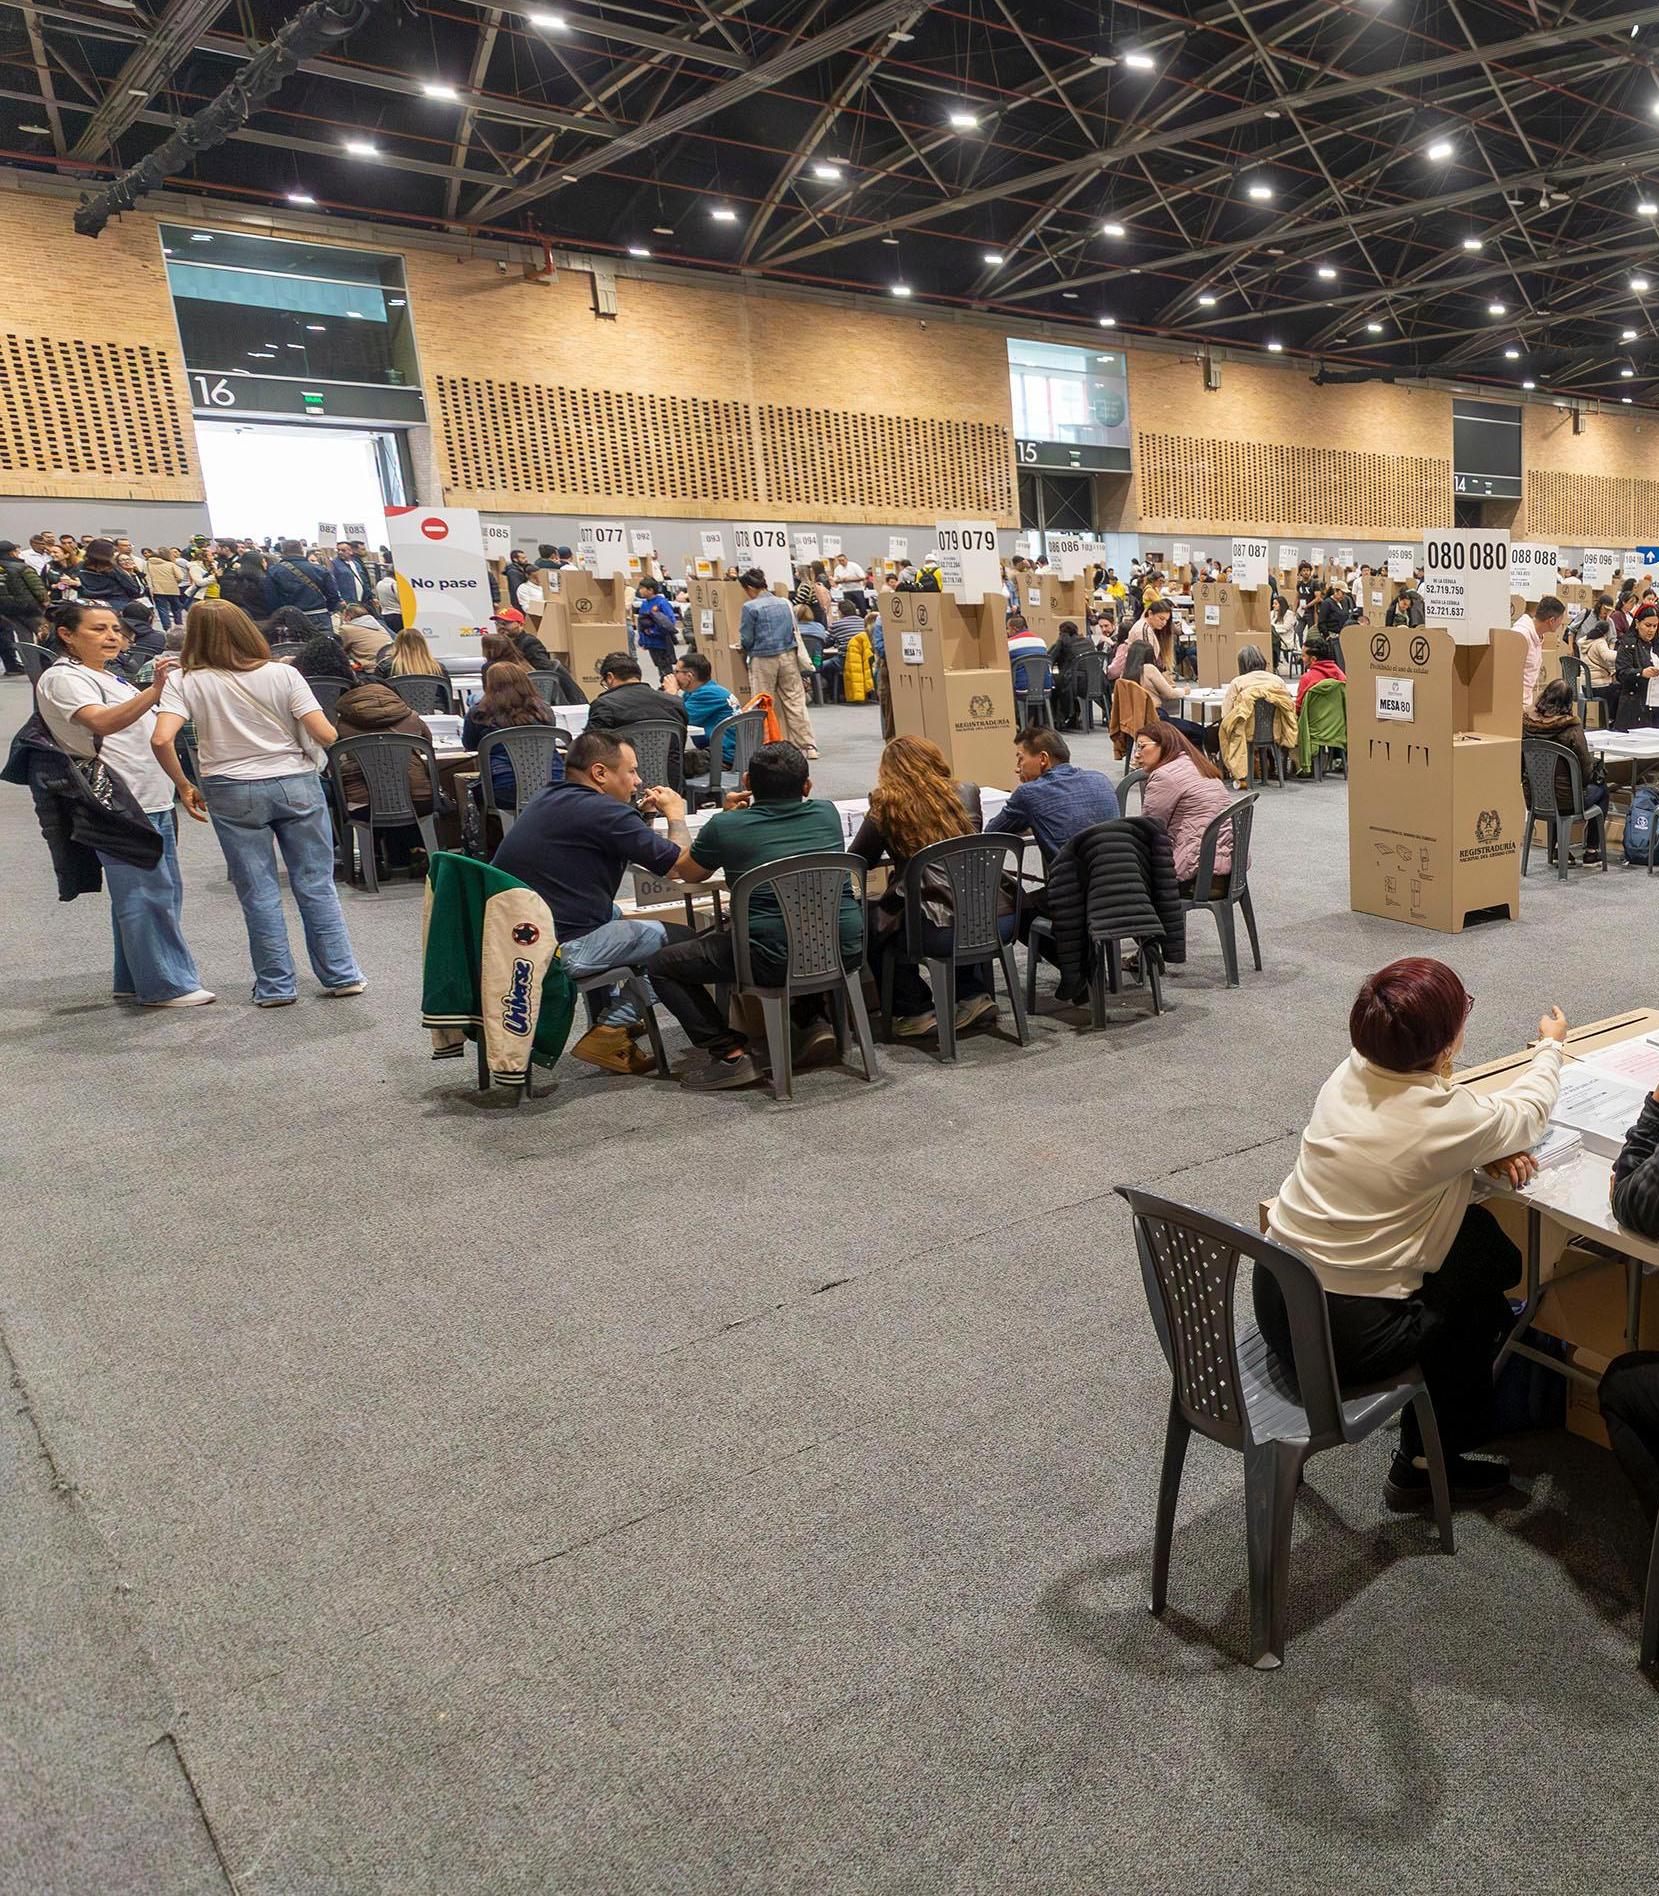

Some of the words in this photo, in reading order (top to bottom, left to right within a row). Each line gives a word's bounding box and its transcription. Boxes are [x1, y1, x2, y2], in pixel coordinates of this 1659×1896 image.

[194, 376, 236, 406] 16
[1017, 442, 1037, 462] 15
[1454, 476, 1466, 492] 14
[320, 524, 337, 535] 082
[489, 528, 509, 540] 085
[580, 528, 593, 543] 077
[596, 528, 624, 542] 077
[706, 534, 721, 544] 093
[736, 530, 750, 548] 078
[754, 530, 786, 548] 078
[938, 530, 960, 551] 079
[962, 530, 996, 551] 079
[1049, 541, 1060, 553] 086
[1061, 541, 1080, 553] 086
[1232, 544, 1246, 558] 087
[1248, 544, 1267, 558] 087
[1388, 550, 1400, 560] 095
[1400, 550, 1413, 560] 095
[1428, 542, 1466, 570] 080
[1470, 542, 1507, 571] 080
[1512, 550, 1532, 564] 088
[1534, 550, 1558, 566] 088
[1584, 554, 1598, 565] 096
[1600, 554, 1613, 566] 096
[411, 578, 435, 590] No
[440, 580, 478, 592] pase
[1426, 584, 1464, 596] 52.719.750
[1426, 606, 1465, 617] 52.721.637
[1380, 699, 1400, 711] MESA
[1401, 702, 1410, 713] 80
[954, 718, 1010, 730] REGISTRADURÍA
[1459, 840, 1516, 858] REGISTRADURÍA
[502, 958, 534, 1036] Universe
